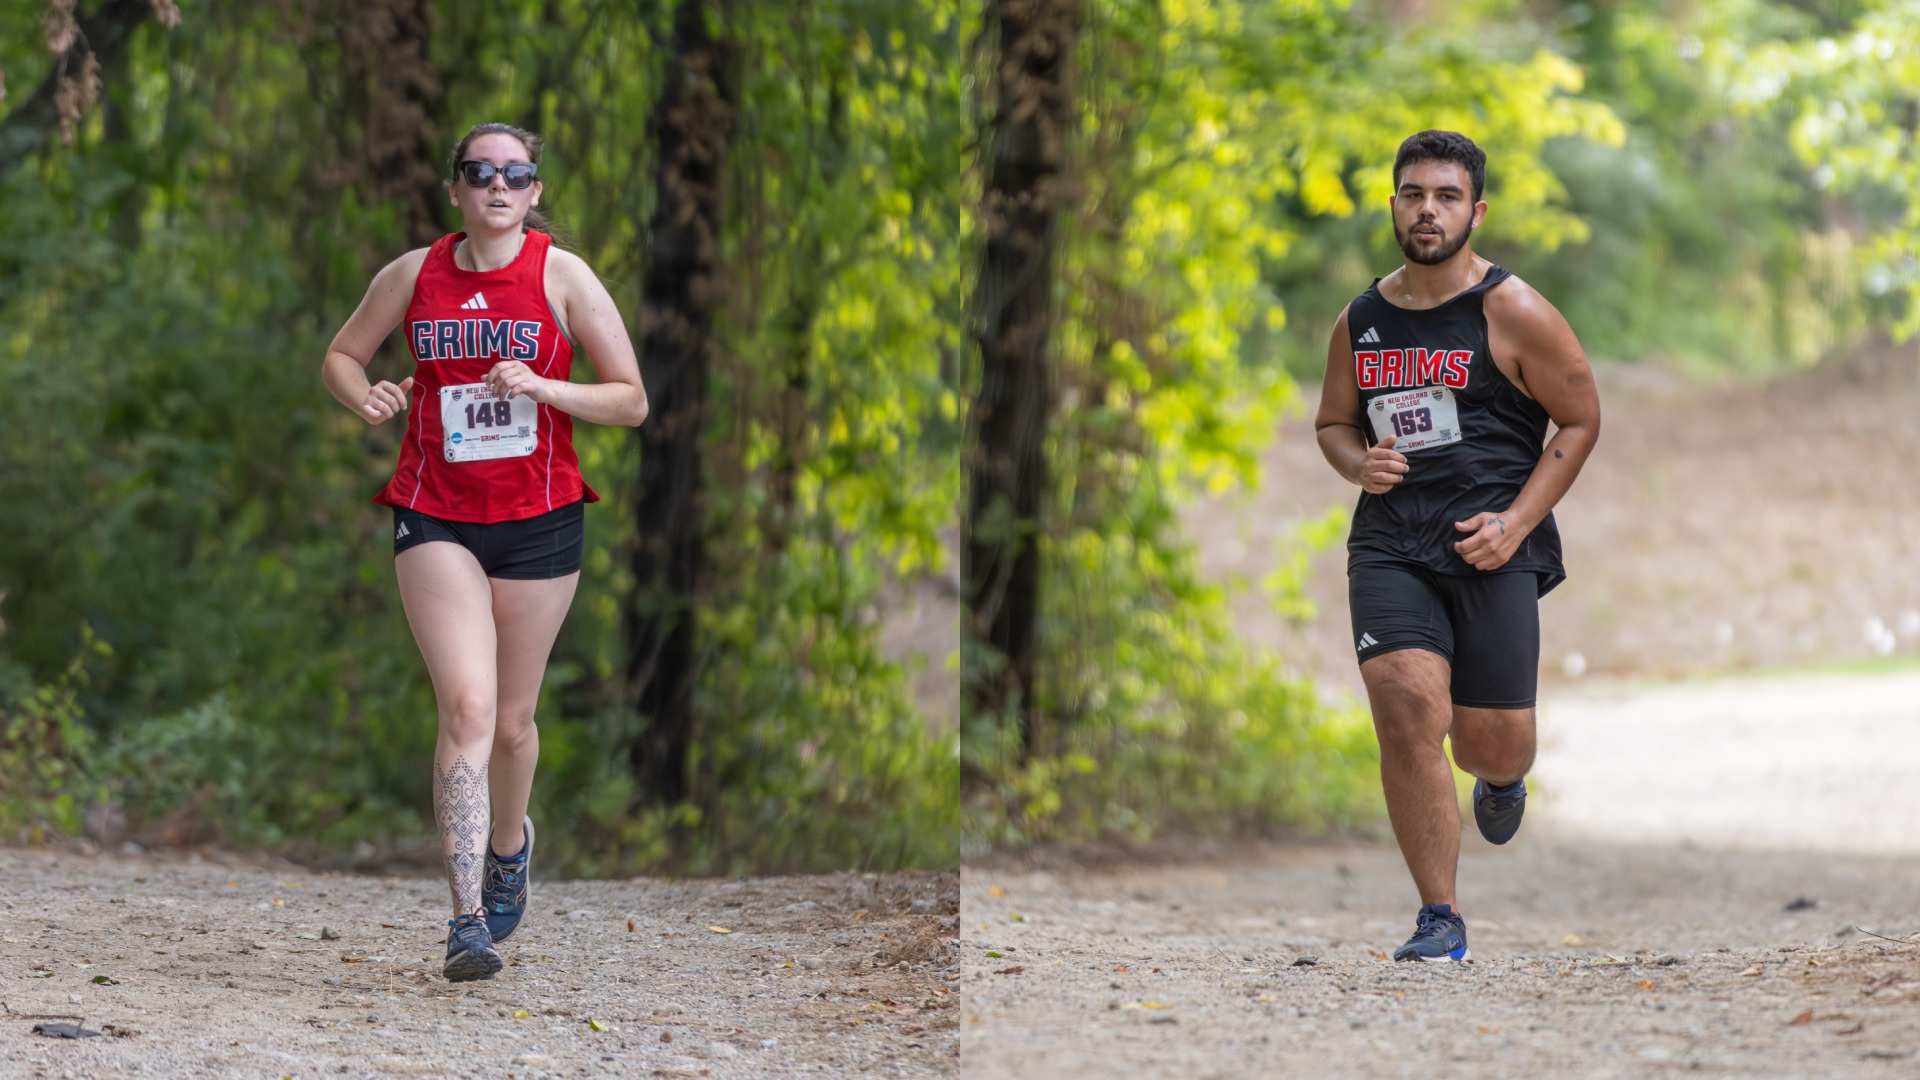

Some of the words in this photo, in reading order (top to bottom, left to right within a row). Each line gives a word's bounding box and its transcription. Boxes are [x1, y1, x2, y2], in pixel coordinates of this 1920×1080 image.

[412, 319, 542, 361] GRIMS
[1354, 347, 1474, 390] GRIMS
[466, 387, 480, 395] NEW
[474, 391, 493, 400] COLLE
[1387, 397, 1401, 405] NEW
[1401, 391, 1428, 402] ENGLAND
[1395, 399, 1421, 410] COLLEGE
[465, 401, 512, 429] 148
[1390, 407, 1433, 438] 153
[481, 434, 500, 442] GRIMS
[1407, 439, 1425, 449] GRIMS
